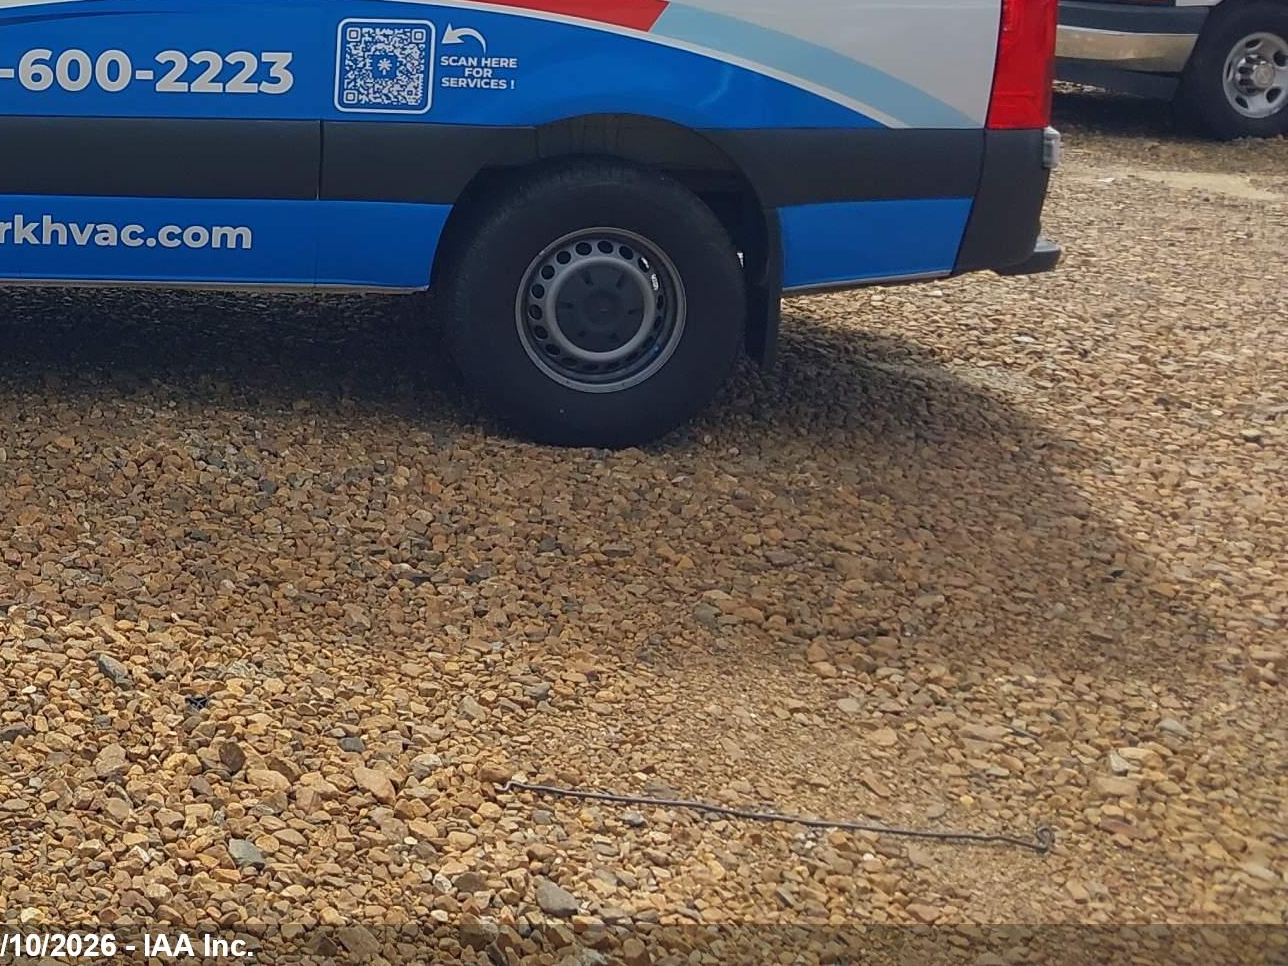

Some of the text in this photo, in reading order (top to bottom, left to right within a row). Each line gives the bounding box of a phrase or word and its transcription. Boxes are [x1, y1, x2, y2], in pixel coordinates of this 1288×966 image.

[441, 56, 518, 68] SCAN HERE
[464, 67, 492, 78] FOR
[441, 77, 507, 90] SERVICES
